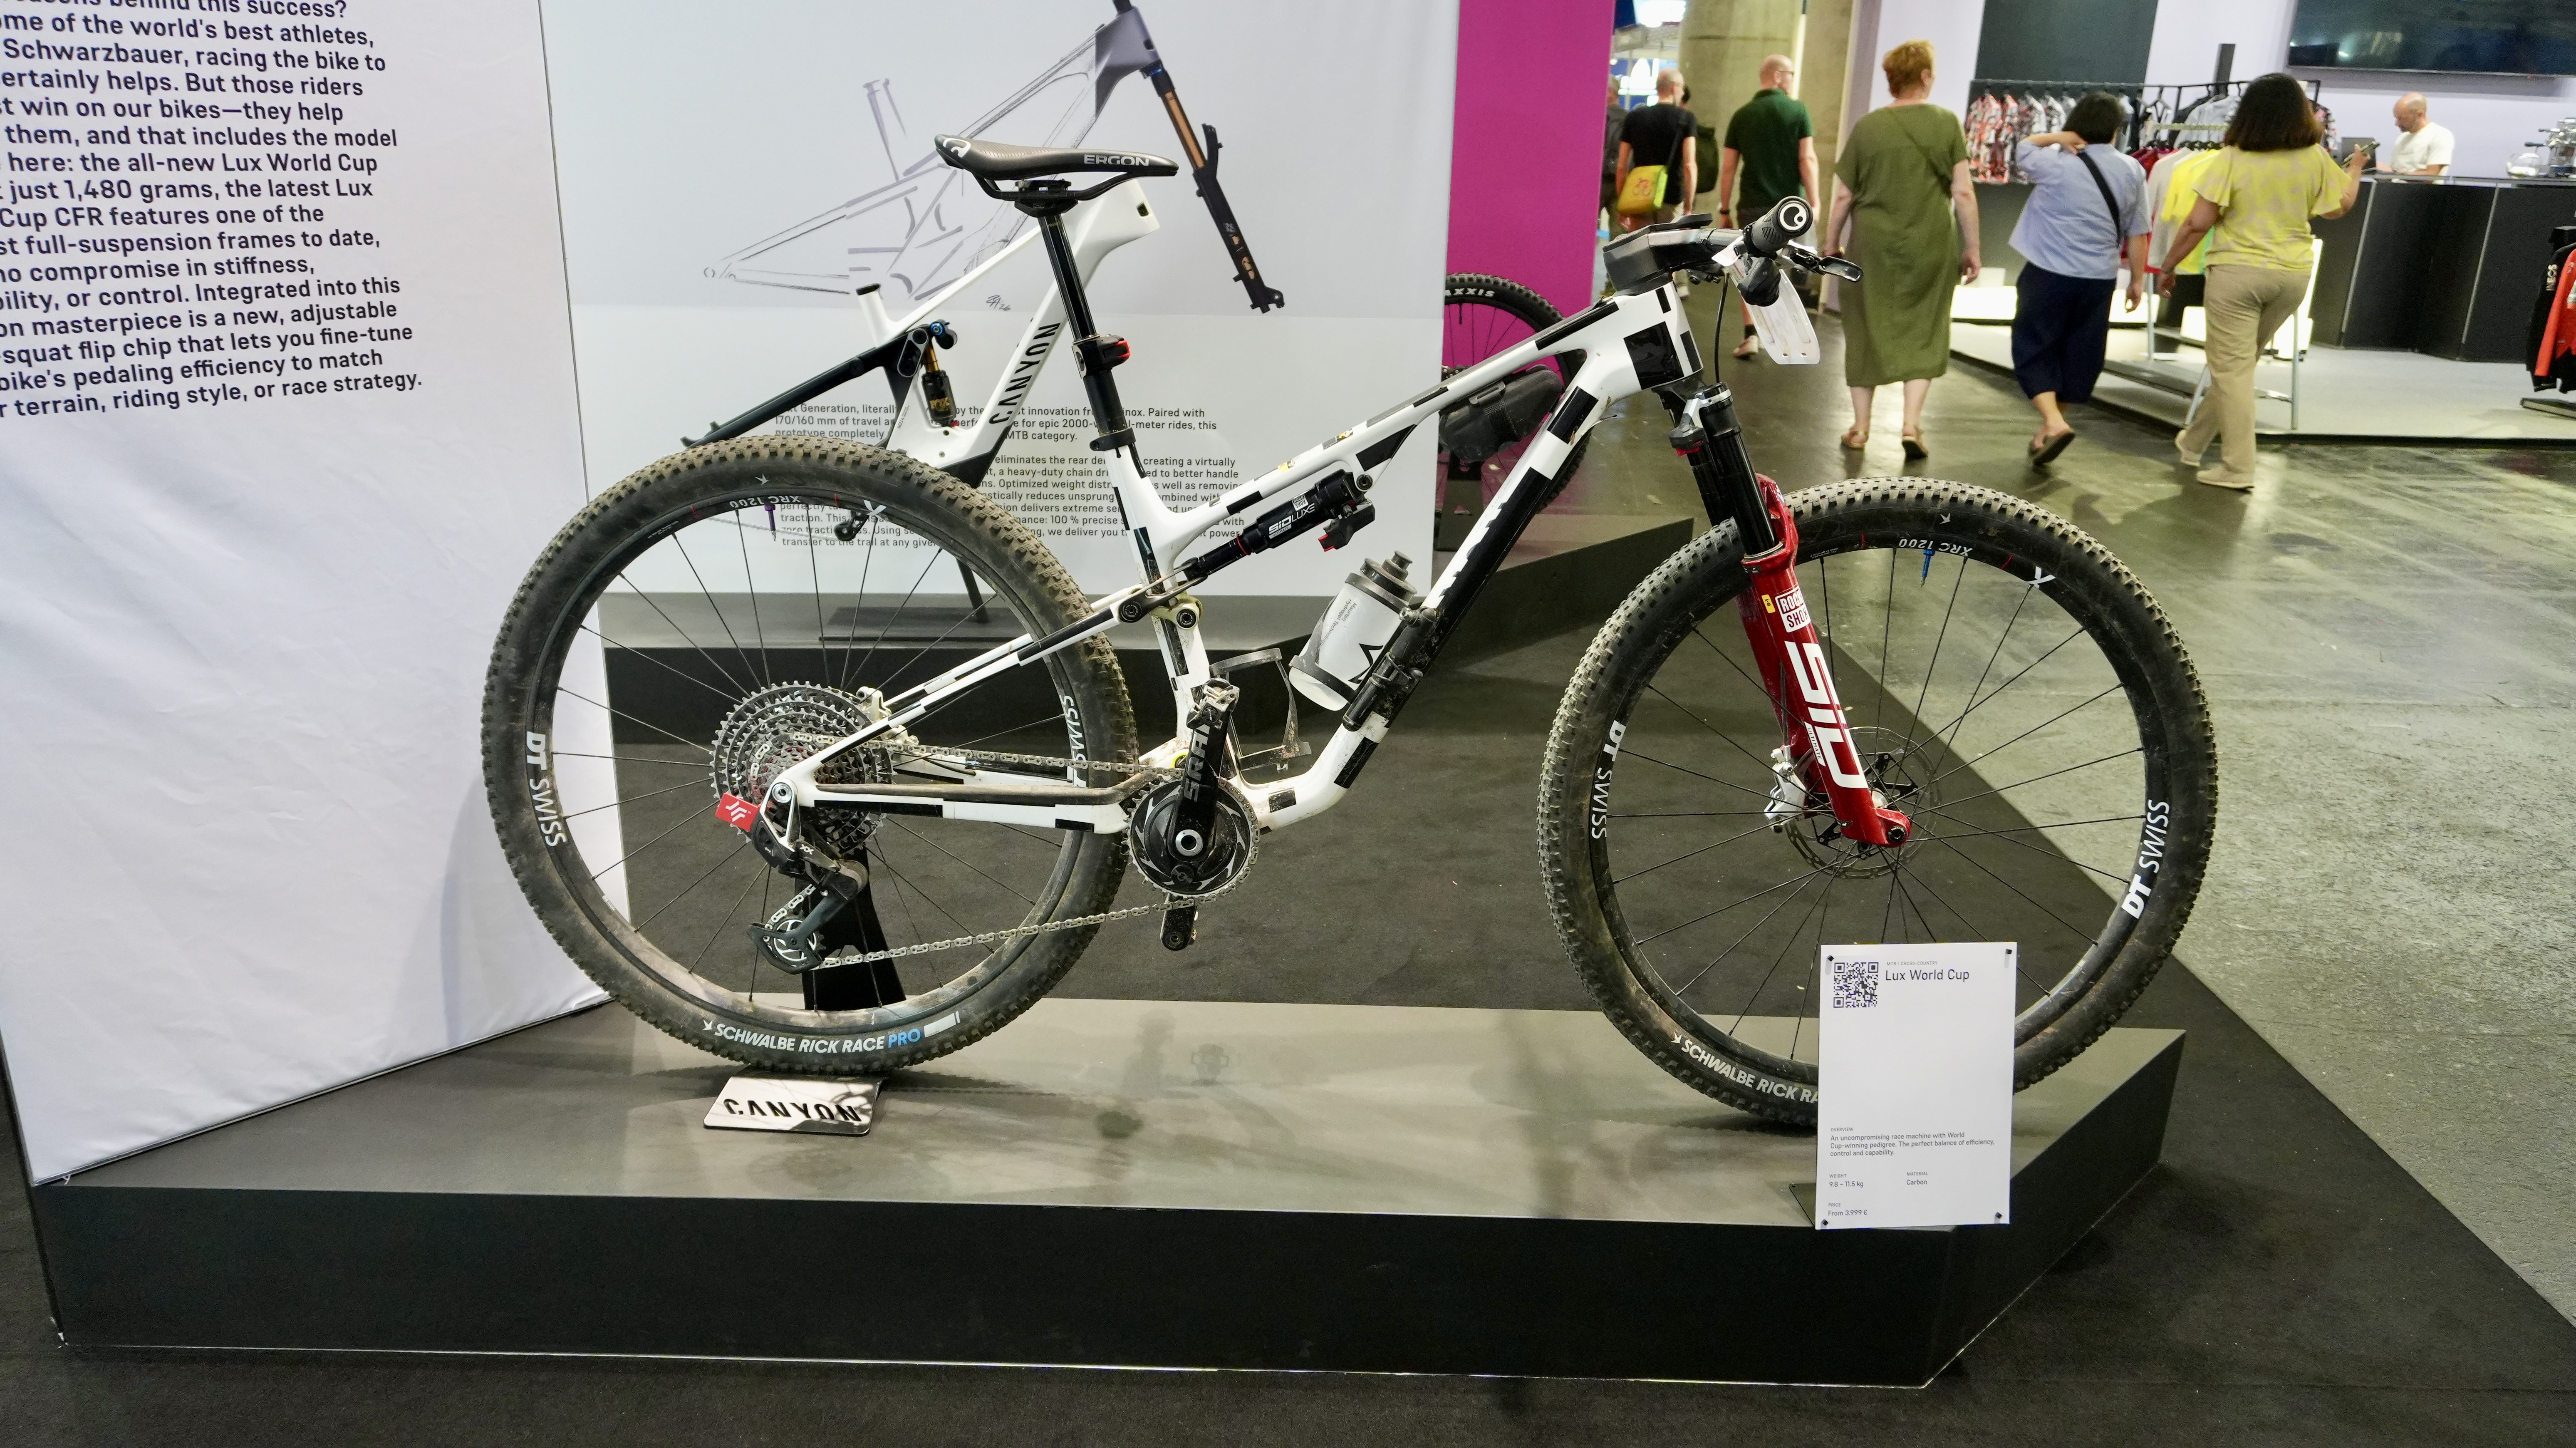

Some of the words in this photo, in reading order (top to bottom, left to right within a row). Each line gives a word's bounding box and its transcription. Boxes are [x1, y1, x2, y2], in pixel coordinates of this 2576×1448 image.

[3, 38, 188, 67] Schwarzbauer,
[196, 48, 267, 72] racing
[272, 49, 309, 68] the
[315, 50, 359, 70] bike
[364, 55, 385, 71] to
[1, 69, 99, 94] ertainly
[107, 70, 178, 96] helps.
[185, 72, 226, 92] But
[231, 74, 293, 94] those
[301, 77, 363, 96] riders
[20, 97, 68, 116] win
[76, 102, 105, 117] on
[114, 103, 152, 117] our
[298, 102, 343, 125] help
[5, 124, 79, 147] them,
[87, 125, 131, 144] and
[137, 126, 186, 145] that
[192, 126, 287, 146] includes
[292, 128, 327, 146] the
[334, 129, 397, 146] model
[7, 152, 73, 171] here:
[79, 152, 120, 171] the
[128, 153, 214, 171] all-new
[222, 153, 263, 171] Lux
[266, 153, 332, 171] World
[338, 154, 377, 176] Cup
[1083, 154, 1150, 167] ERGON
[10, 180, 59, 205] just
[64, 179, 131, 202] 1,480
[140, 184, 219, 203] grams,
[225, 179, 261, 197] the
[268, 179, 330, 197] latest
[336, 179, 373, 196] Lux
[0, 208, 47, 232] Cup
[55, 207, 104, 226] CFR
[109, 207, 209, 225] features
[216, 210, 255, 223] one
[263, 205, 283, 223] of
[289, 204, 324, 222] the
[988, 322, 1062, 424] CANYON
[801, 404, 859, 414] Generation,
[1028, 407, 1080, 415] innovation
[1148, 407, 1179, 417] Paired
[1182, 408, 1205, 417] with
[775, 416, 814, 425] 170/160
[839, 416, 849, 425] of
[852, 417, 881, 425] travel
[1021, 419, 1035, 427] for
[1039, 419, 1059, 429] epic
[1168, 420, 1195, 430] rides,
[1198, 421, 1217, 429] this
[828, 429, 884, 439] completely
[1031, 432, 1077, 442] category.
[995, 455, 1046, 464] eliminates
[1049, 455, 1065, 464] the
[1143, 458, 1184, 467] creating
[1195, 457, 1236, 468] virtually
[1007, 467, 1063, 479] heavy-duty
[1066, 468, 1092, 476] chain
[1173, 469, 1204, 478] better
[1206, 469, 1238, 478] handle
[998, 479, 1048, 490] Optimized
[1051, 479, 1085, 491] weight
[1162, 481, 1182, 489] well
[729, 497, 765, 508] 1200
[768, 495, 801, 504] XRC
[1021, 503, 1060, 512] delivers
[1026, 491, 1065, 500] reduces
[1068, 493, 1114, 503] unsprung
[1050, 515, 1067, 524] 100
[1070, 515, 1079, 524] %
[1082, 516, 1117, 526] precise
[1291, 503, 1315, 523] LUXE
[1065, 527, 1098, 536] deliver
[1101, 530, 1118, 538] you
[1898, 538, 1934, 550] 1200
[1938, 543, 1973, 557] XRC
[1336, 598, 1352, 621] Hydrogel
[1342, 602, 1357, 622] Maurten
[1780, 590, 1804, 613] ROCK
[1786, 607, 1809, 628] SHOX
[1320, 620, 1339, 647] Technology
[1784, 640, 1869, 789] SID
[526, 731, 547, 770] DT
[1807, 727, 1823, 760] ULTIMATE
[528, 778, 567, 847] SWISS
[1590, 767, 1613, 839] SWISS
[2121, 874, 2152, 919] DT
[2139, 798, 2170, 873] SWISS
[1885, 970, 1906, 981] Lux
[1909, 969, 1943, 980] World
[1947, 969, 1969, 982] Cup
[714, 1024, 795, 1051] SCHWALBE
[798, 1039, 838, 1054] RICK
[841, 1035, 885, 1053] RACE
[888, 1028, 921, 1048] PRO
[1681, 1039, 1756, 1088] SCHWALBE
[1756, 1078, 1799, 1101] RICK
[723, 1098, 862, 1122] CANYON
[1865, 1149, 1895, 1157] capability.
[1966, 1138, 1994, 1147] efficiency,
